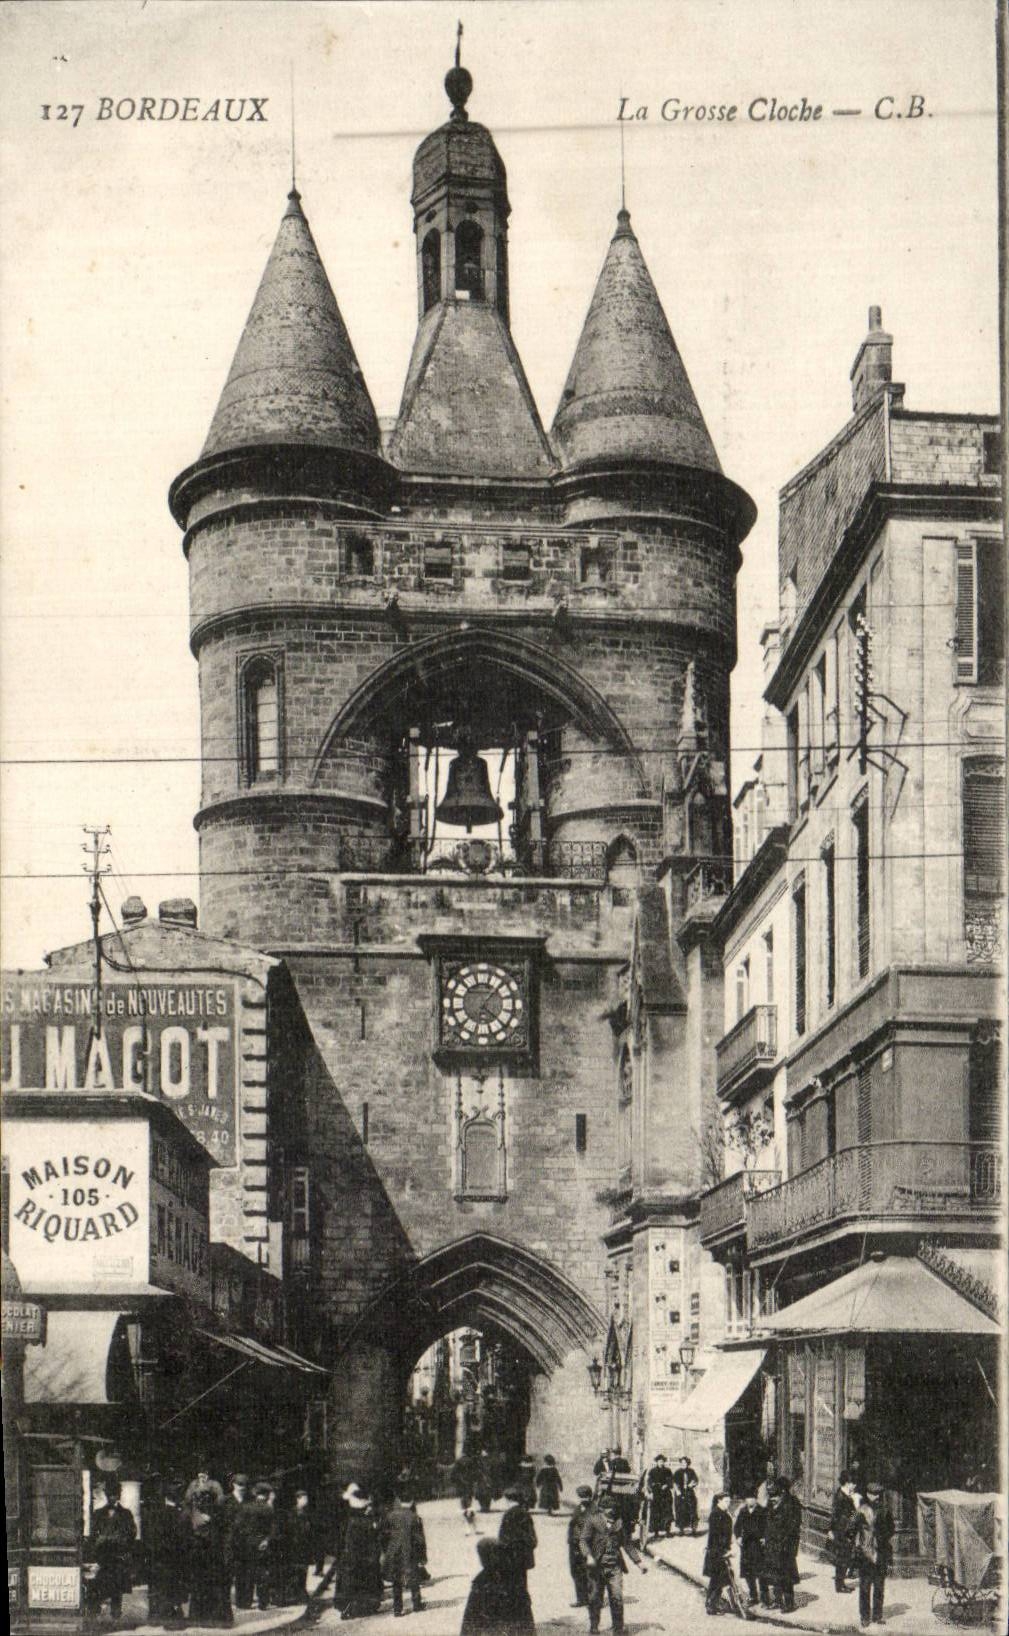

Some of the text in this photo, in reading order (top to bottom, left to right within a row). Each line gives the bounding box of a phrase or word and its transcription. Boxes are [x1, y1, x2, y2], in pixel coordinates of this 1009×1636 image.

[106, 991, 126, 1016] de
[45, 1024, 231, 1100] MAGOT
[21, 1154, 135, 1191] MAISON
[60, 1187, 101, 1207] 105
[13, 1197, 140, 1244] RIQUARD
[31, 1587, 77, 1602] MENIER
